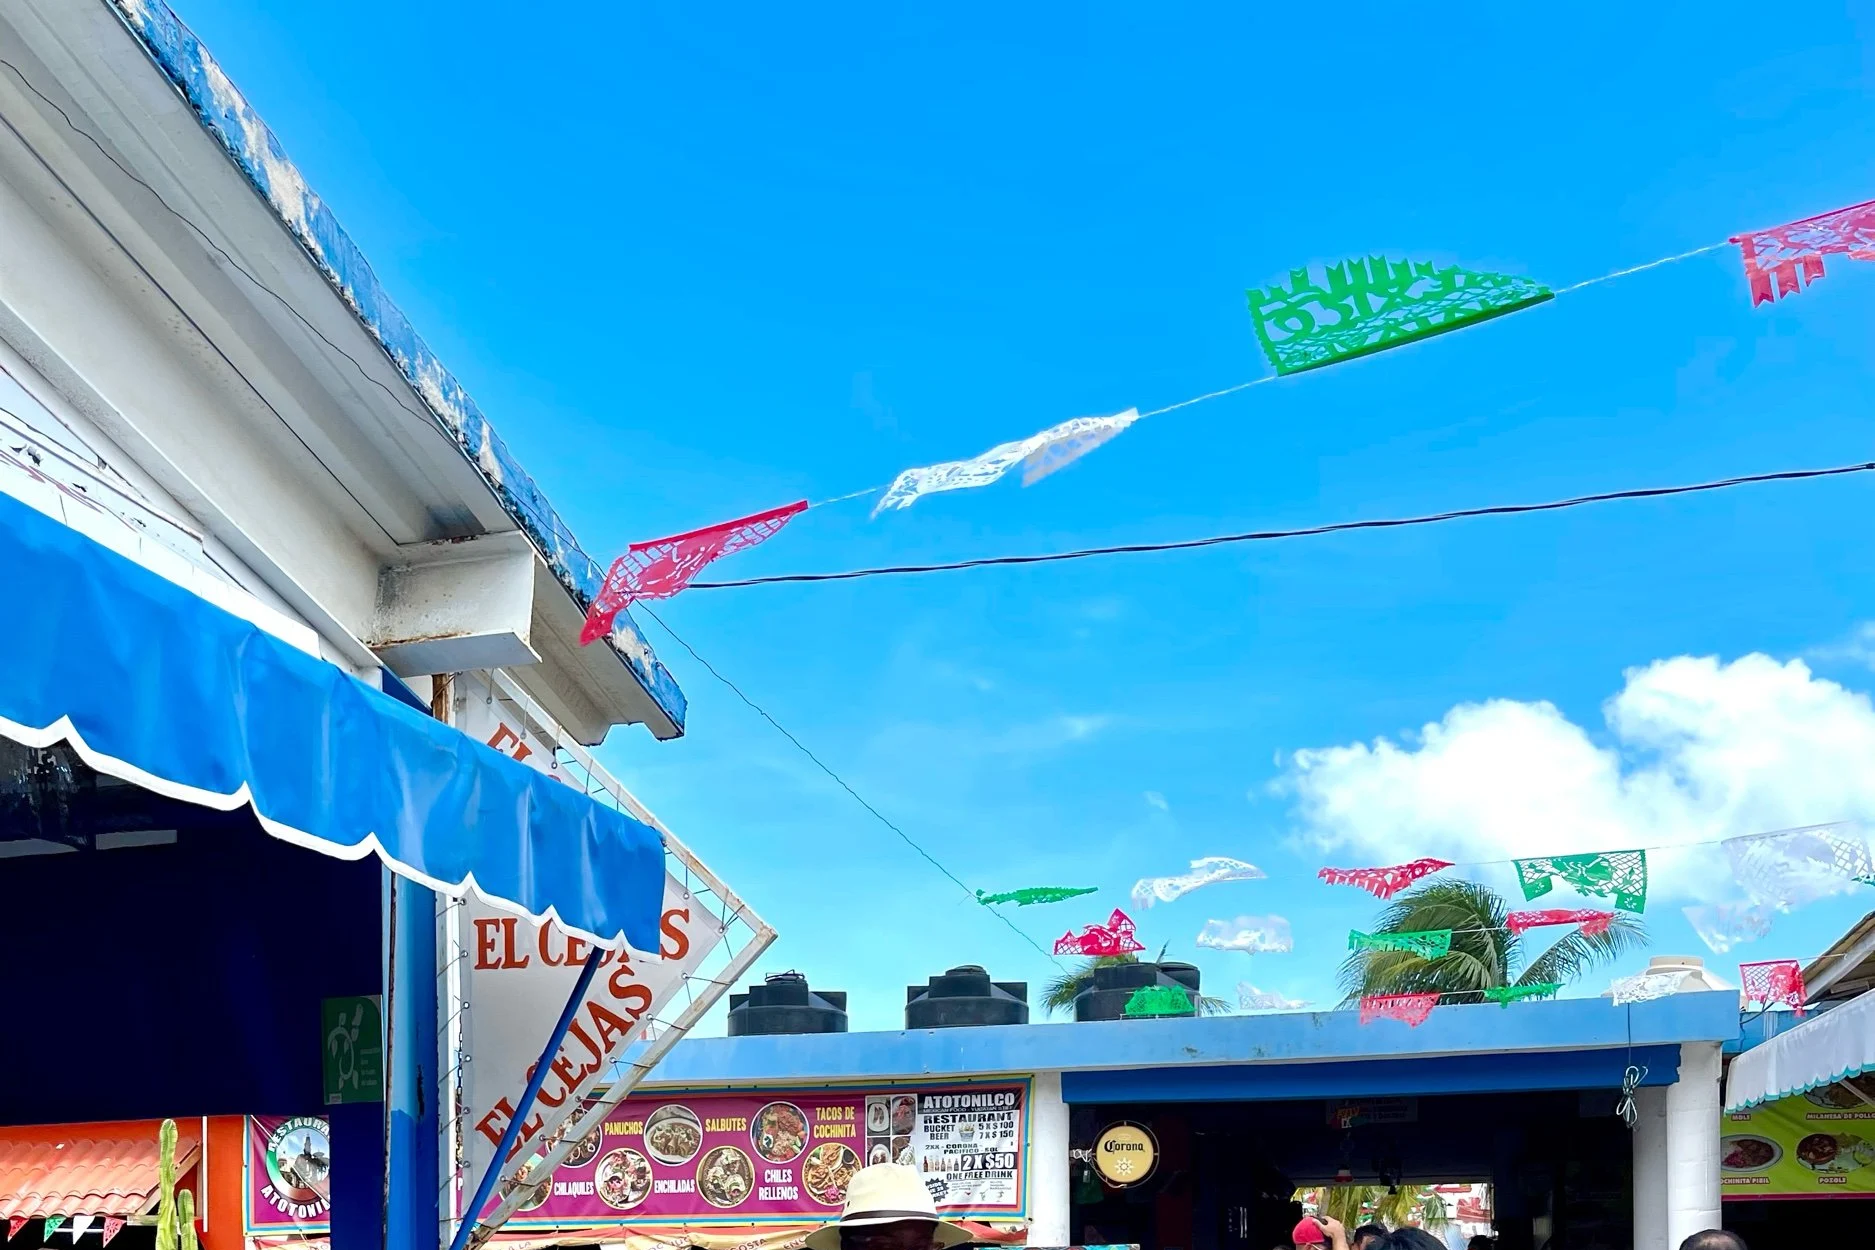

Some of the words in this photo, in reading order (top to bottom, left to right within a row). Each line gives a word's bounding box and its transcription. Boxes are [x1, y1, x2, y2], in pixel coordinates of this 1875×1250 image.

[473, 918, 529, 970] EL
[538, 909, 690, 967] CES
[923, 1093, 1015, 1109] ATOTONILCO
[815, 1107, 842, 1121] TACOS
[844, 1106, 855, 1120] DE
[923, 1112, 1014, 1124] RESTAURANT
[474, 1096, 545, 1164] EL
[604, 1122, 644, 1136] PANUCHOS
[705, 1118, 747, 1132] SALBUTES
[813, 1124, 856, 1139] COCHINITA
[924, 1124, 955, 1133] BUCKET
[1000, 1121, 1014, 1129] 100
[268, 1117, 330, 1153] RESTAURA
[929, 1132, 949, 1140] BEER
[1000, 1130, 1014, 1138] 150
[1104, 1140, 1146, 1154] Corona
[985, 1153, 1014, 1170] $50
[764, 1169, 793, 1183] CHILES
[946, 1172, 963, 1180] ONE
[964, 1171, 983, 1179] FREE
[984, 1170, 1013, 1179] DRINK
[554, 1182, 594, 1198] CHILAQUILES
[653, 1179, 696, 1194] ENCHILADAS
[758, 1187, 799, 1201] RELLENOS
[260, 1184, 331, 1219] ATOTONIL
